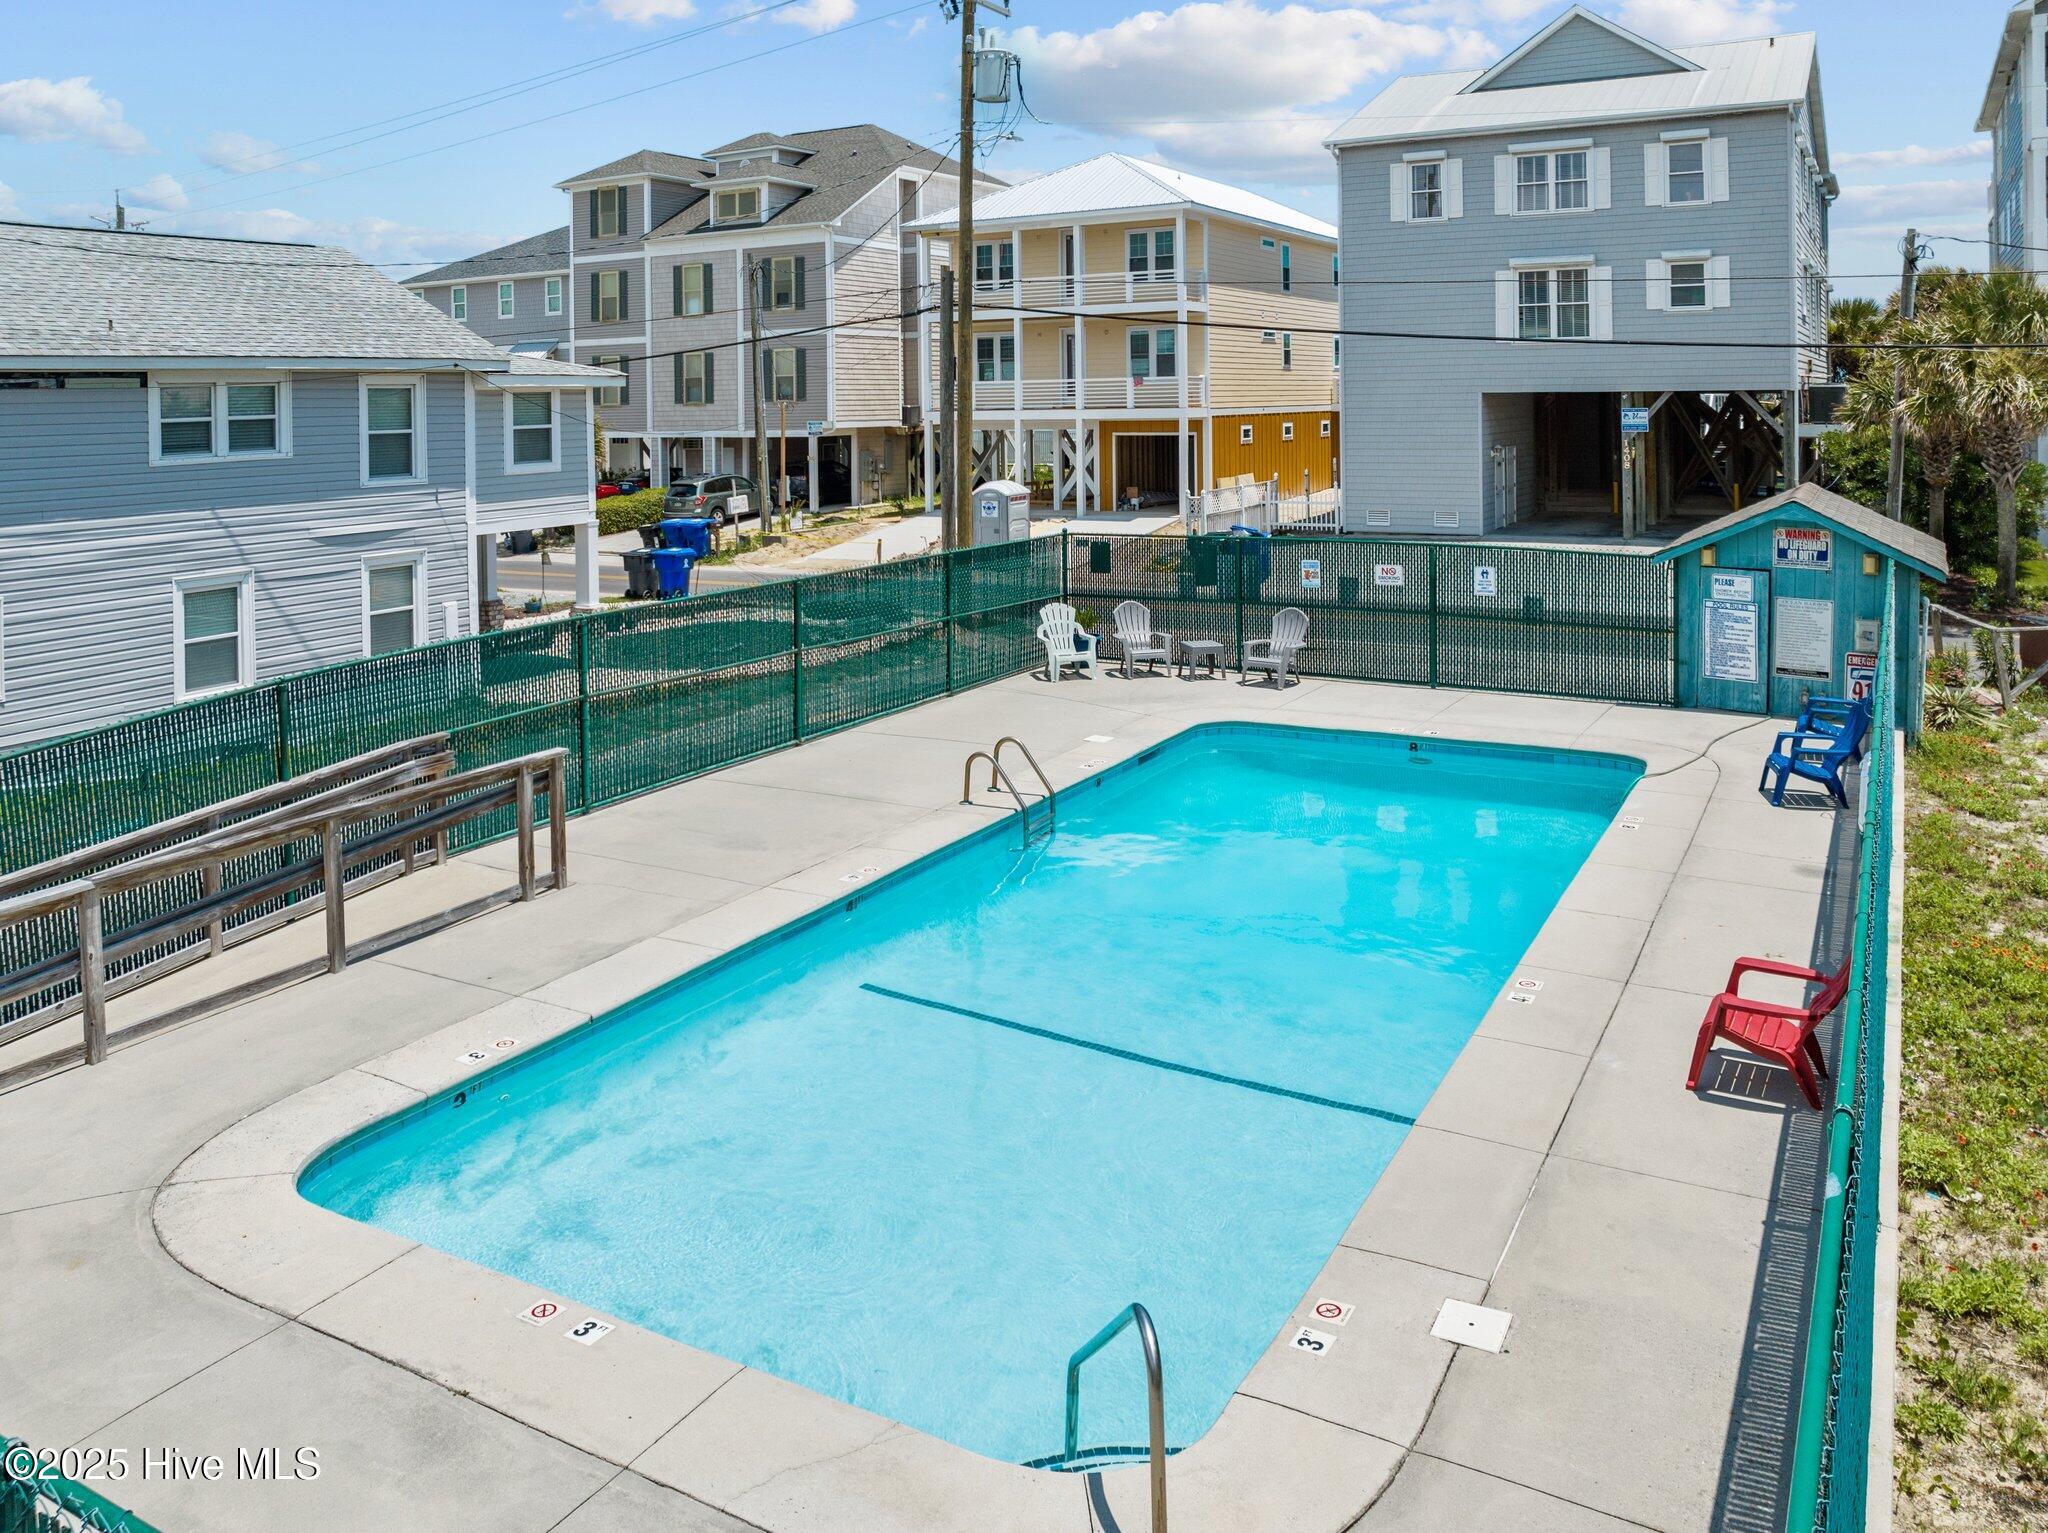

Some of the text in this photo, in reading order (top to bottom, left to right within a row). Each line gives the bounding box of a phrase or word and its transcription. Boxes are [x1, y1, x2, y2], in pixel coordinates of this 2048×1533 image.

[1785, 529, 1821, 540] WARNING
[1778, 539, 1827, 551] NO LIFEGUARD
[1787, 549, 1818, 561] ON DUTY
[1381, 567, 1396, 575] NO
[1714, 578, 1735, 586] PLEASE
[1713, 601, 1748, 611] POOL RULES
[1848, 656, 1875, 666] EMERGE
[573, 1322, 597, 1336] 3
[1297, 1337, 1324, 1351] 3
